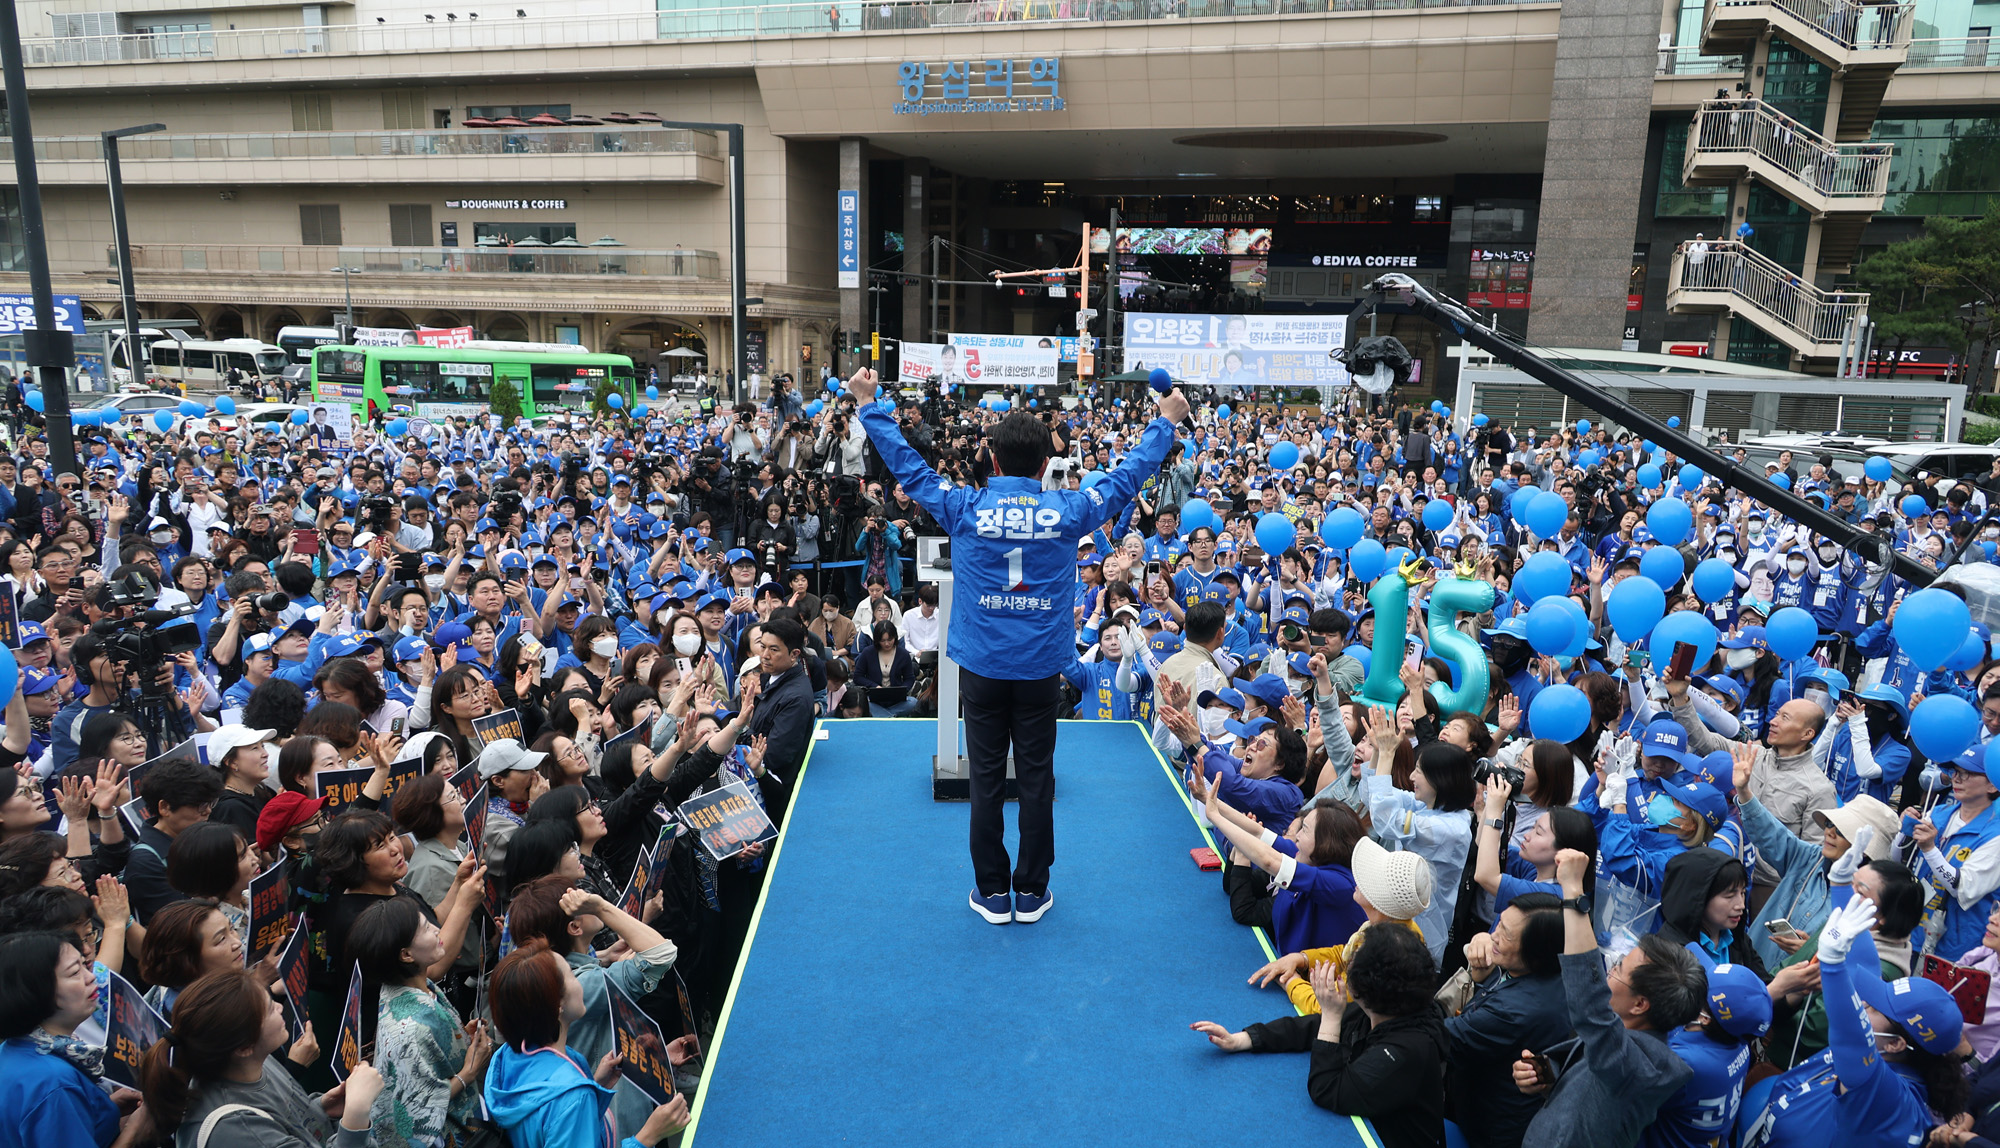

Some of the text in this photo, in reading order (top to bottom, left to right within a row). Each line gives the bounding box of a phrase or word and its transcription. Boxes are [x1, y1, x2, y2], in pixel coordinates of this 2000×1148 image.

[897, 57, 1059, 102] 왕십리역
[892, 100, 1011, 116] Wangsimni Station
[461, 199, 520, 209] DOUGHNUTS
[522, 200, 529, 209] &
[531, 200, 565, 209] COFFEE
[1202, 213, 1254, 223] JUNO HAIR
[843, 215, 854, 251] 주차장
[1323, 256, 1417, 267] EDIYA COFFEE
[953, 335, 1025, 348] 계속되는 성동시대
[352, 361, 364, 373] 08
[432, 407, 453, 415] 위너스
[310, 433, 319, 449] 1
[975, 507, 1062, 540] 정원오
[1153, 544, 1158, 553] 1
[1002, 547, 1029, 592] 1
[978, 594, 1052, 611] 서울시장후보
[1655, 732, 1679, 746] 고성미
[1700, 767, 1715, 784] 1-가
[325, 781, 368, 807] 장애
[688, 793, 755, 830] 자립지원 확대하는
[1706, 810, 1720, 826] 1-가
[707, 814, 769, 849] 서울시장!
[1711, 992, 1733, 1021] 1-가
[1906, 1013, 1937, 1043] 1-가
